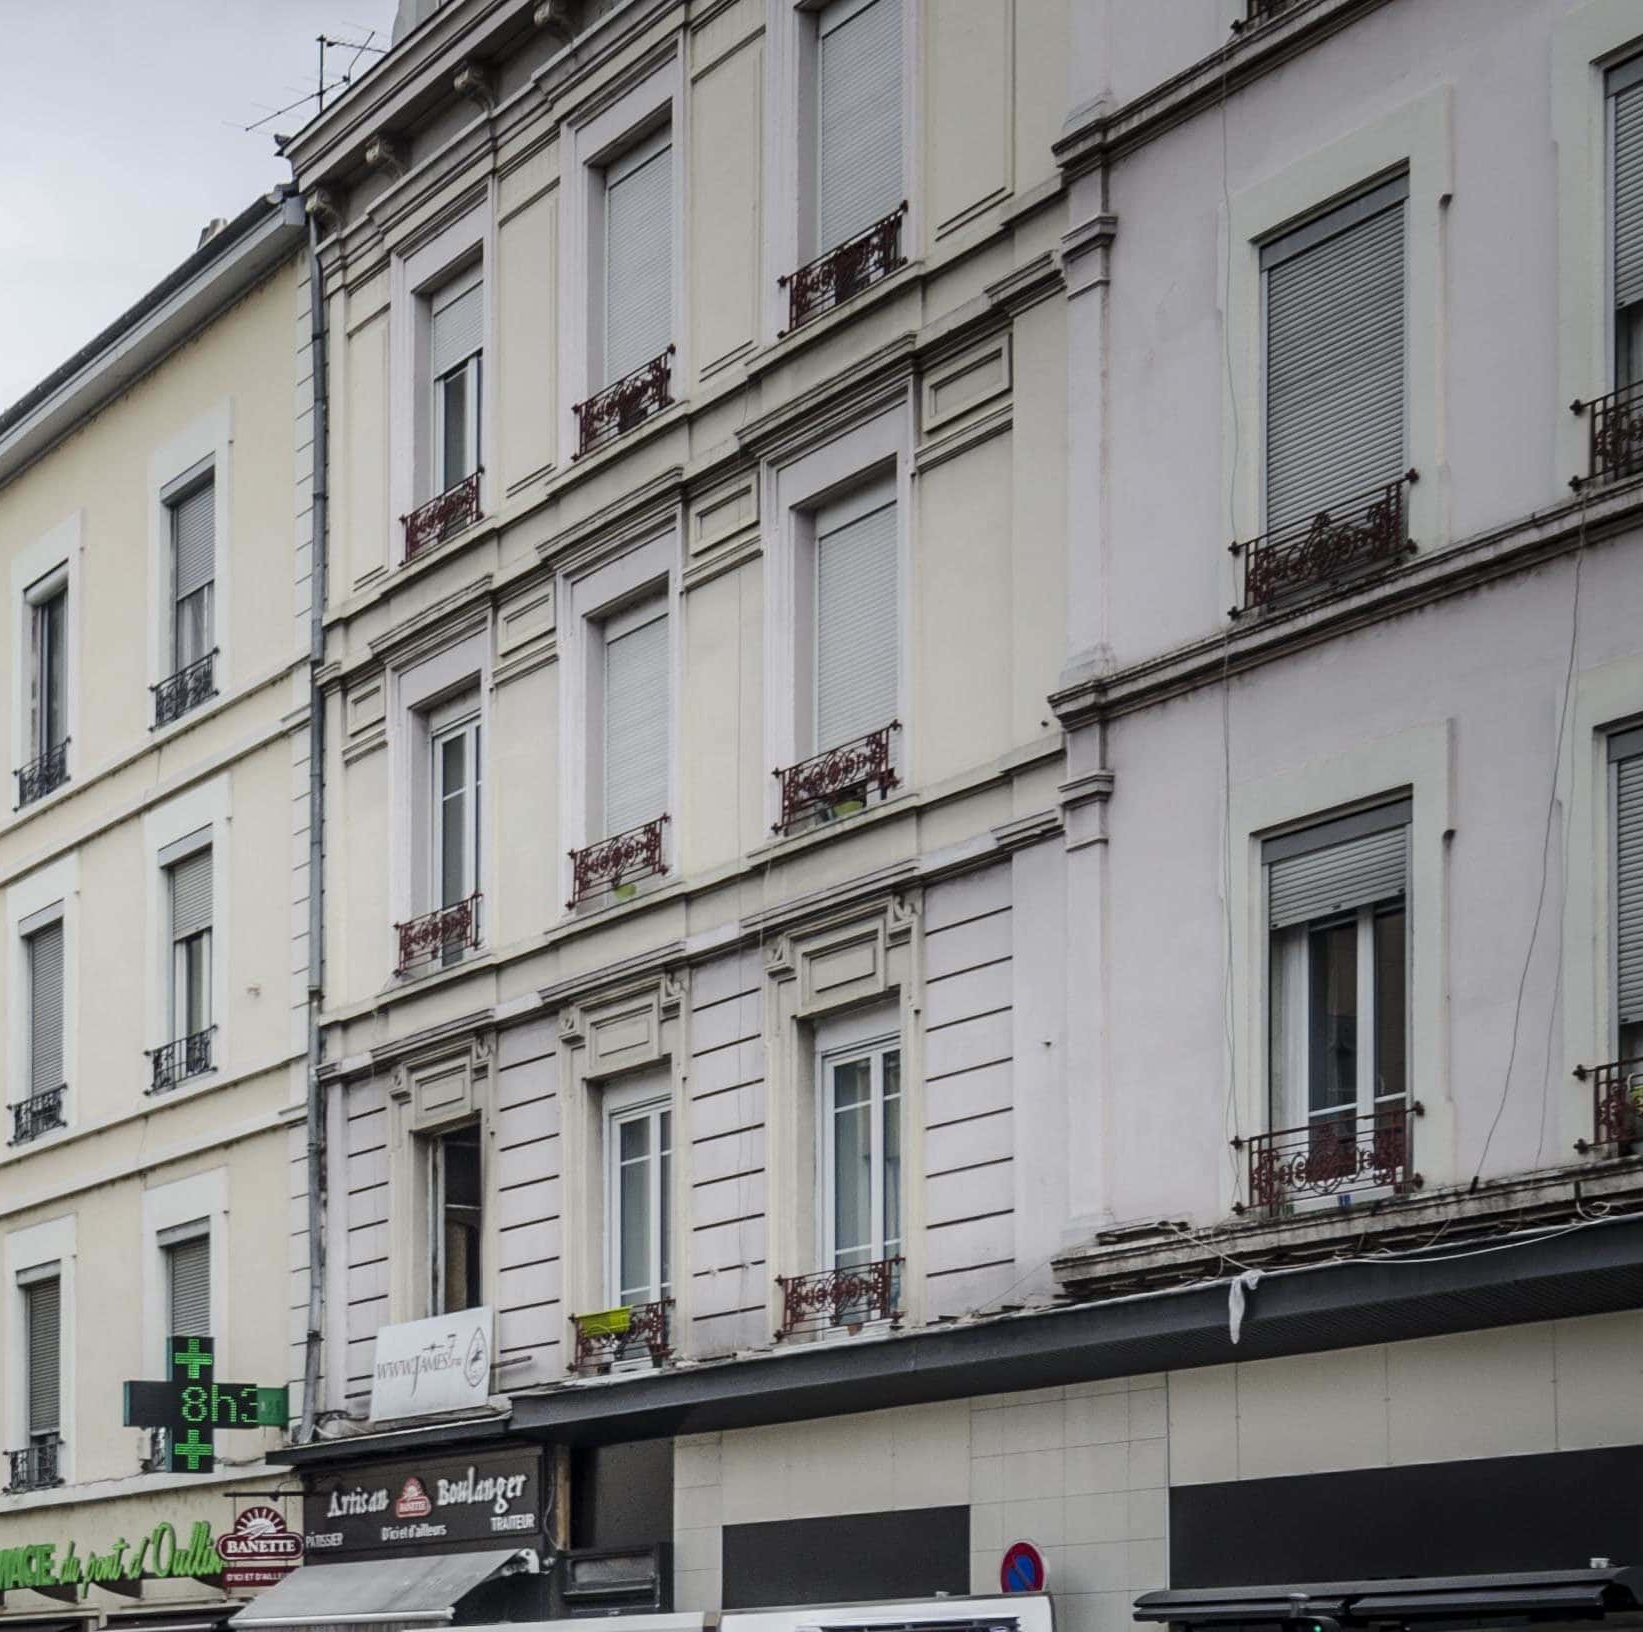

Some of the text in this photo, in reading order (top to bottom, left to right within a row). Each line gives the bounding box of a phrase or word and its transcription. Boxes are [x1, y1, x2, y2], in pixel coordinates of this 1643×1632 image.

[327, 1486, 389, 1517] Artisan
[437, 1465, 527, 1514] Boulanger
[490, 1513, 535, 1530] TRAITEUR
[226, 1540, 296, 1553] BANETTE
